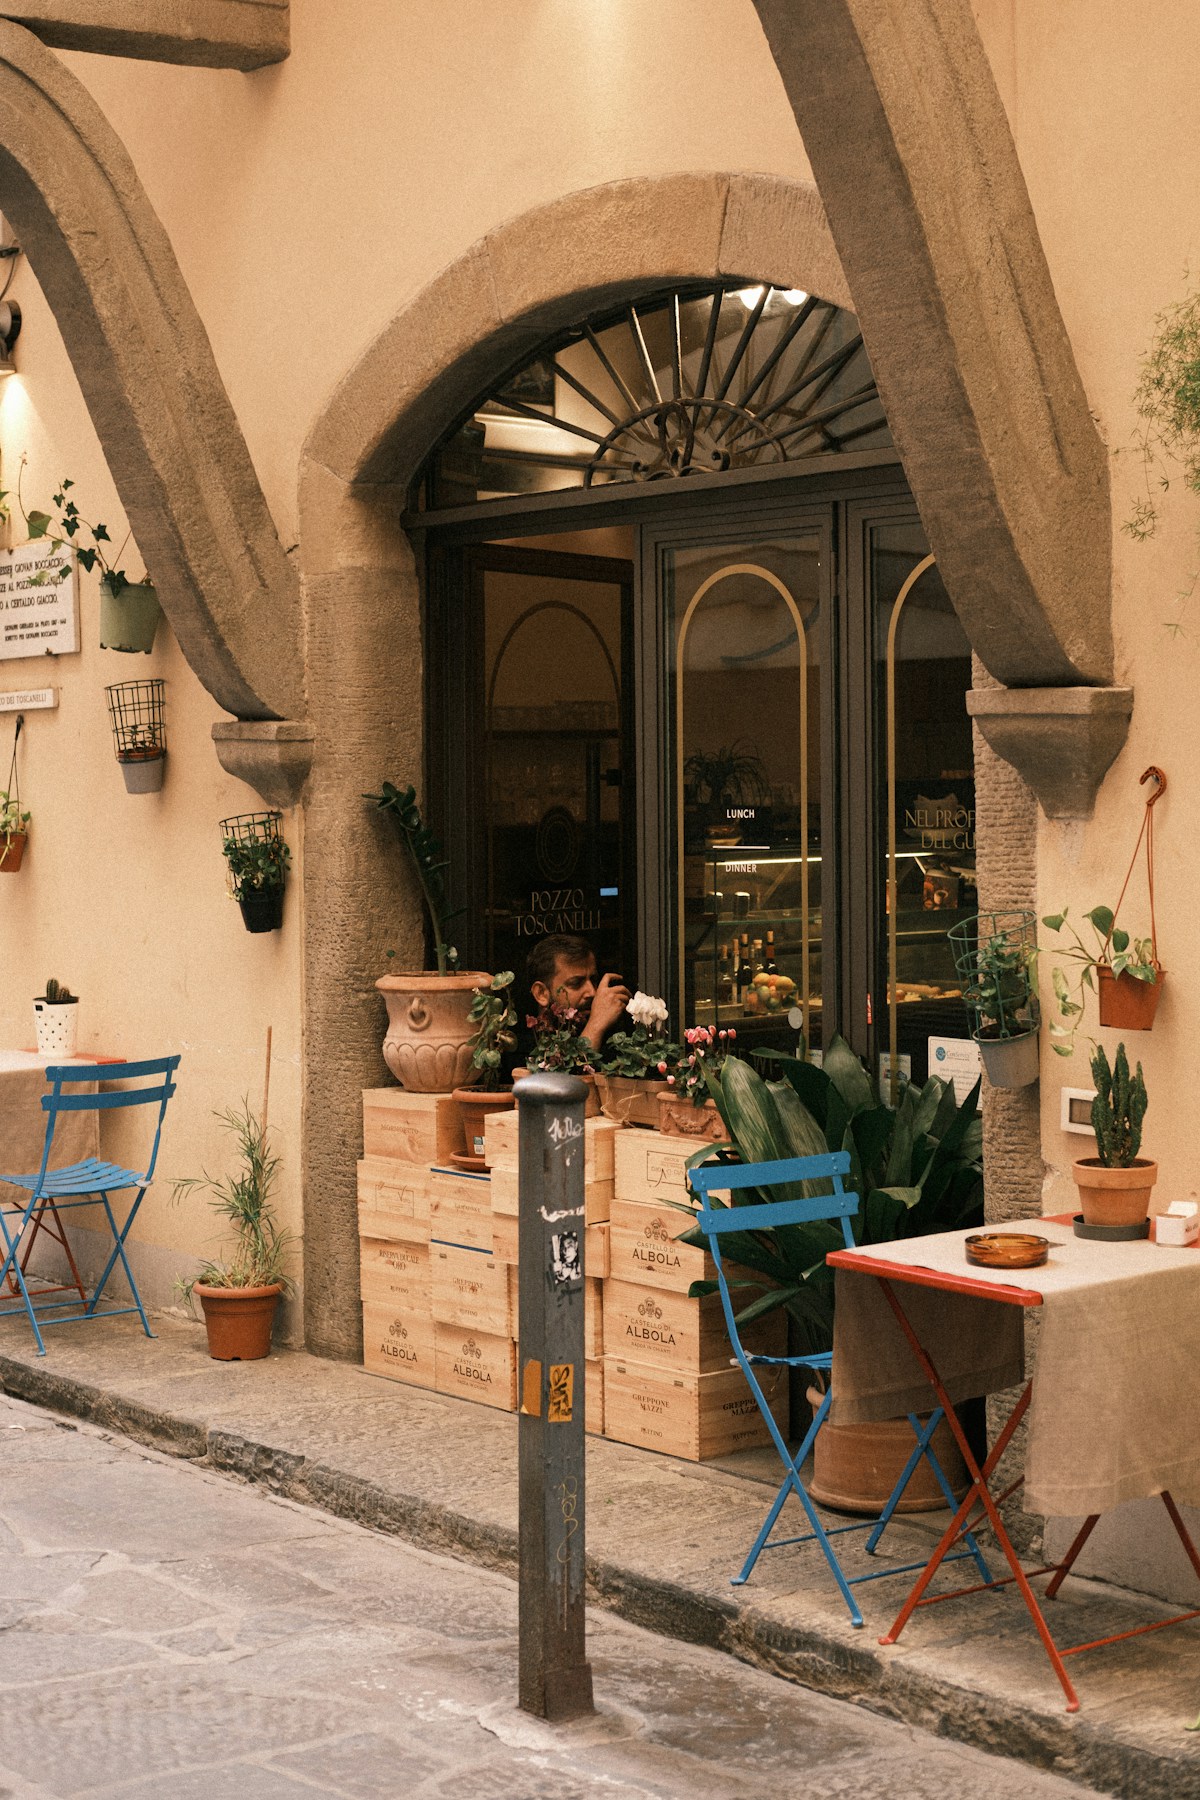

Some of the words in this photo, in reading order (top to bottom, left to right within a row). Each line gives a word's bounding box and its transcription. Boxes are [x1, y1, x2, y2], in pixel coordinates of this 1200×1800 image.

[11, 597, 35, 609] CERTALDO
[16, 693, 47, 704] TOSCANELLI
[726, 809, 755, 819] LUNCH
[905, 809, 934, 828] NEL
[921, 831, 951, 849] DEL
[725, 863, 757, 873] DINNER
[530, 888, 584, 912] POZZO
[511, 909, 600, 936] TOSCANELLI
[636, 1240, 668, 1253] CASTELLO
[632, 1248, 682, 1268] ALBOLA
[630, 1317, 663, 1330] CASTELLO
[625, 1325, 676, 1346] ALBOLA
[384, 1337, 407, 1349] CASTELLO
[380, 1343, 418, 1363] ALBOLA
[457, 1357, 482, 1369] CASTELLO
[453, 1363, 493, 1384] ALBOLA
[632, 1393, 670, 1409] GREPPONE
[640, 1402, 663, 1414] MAZZI
